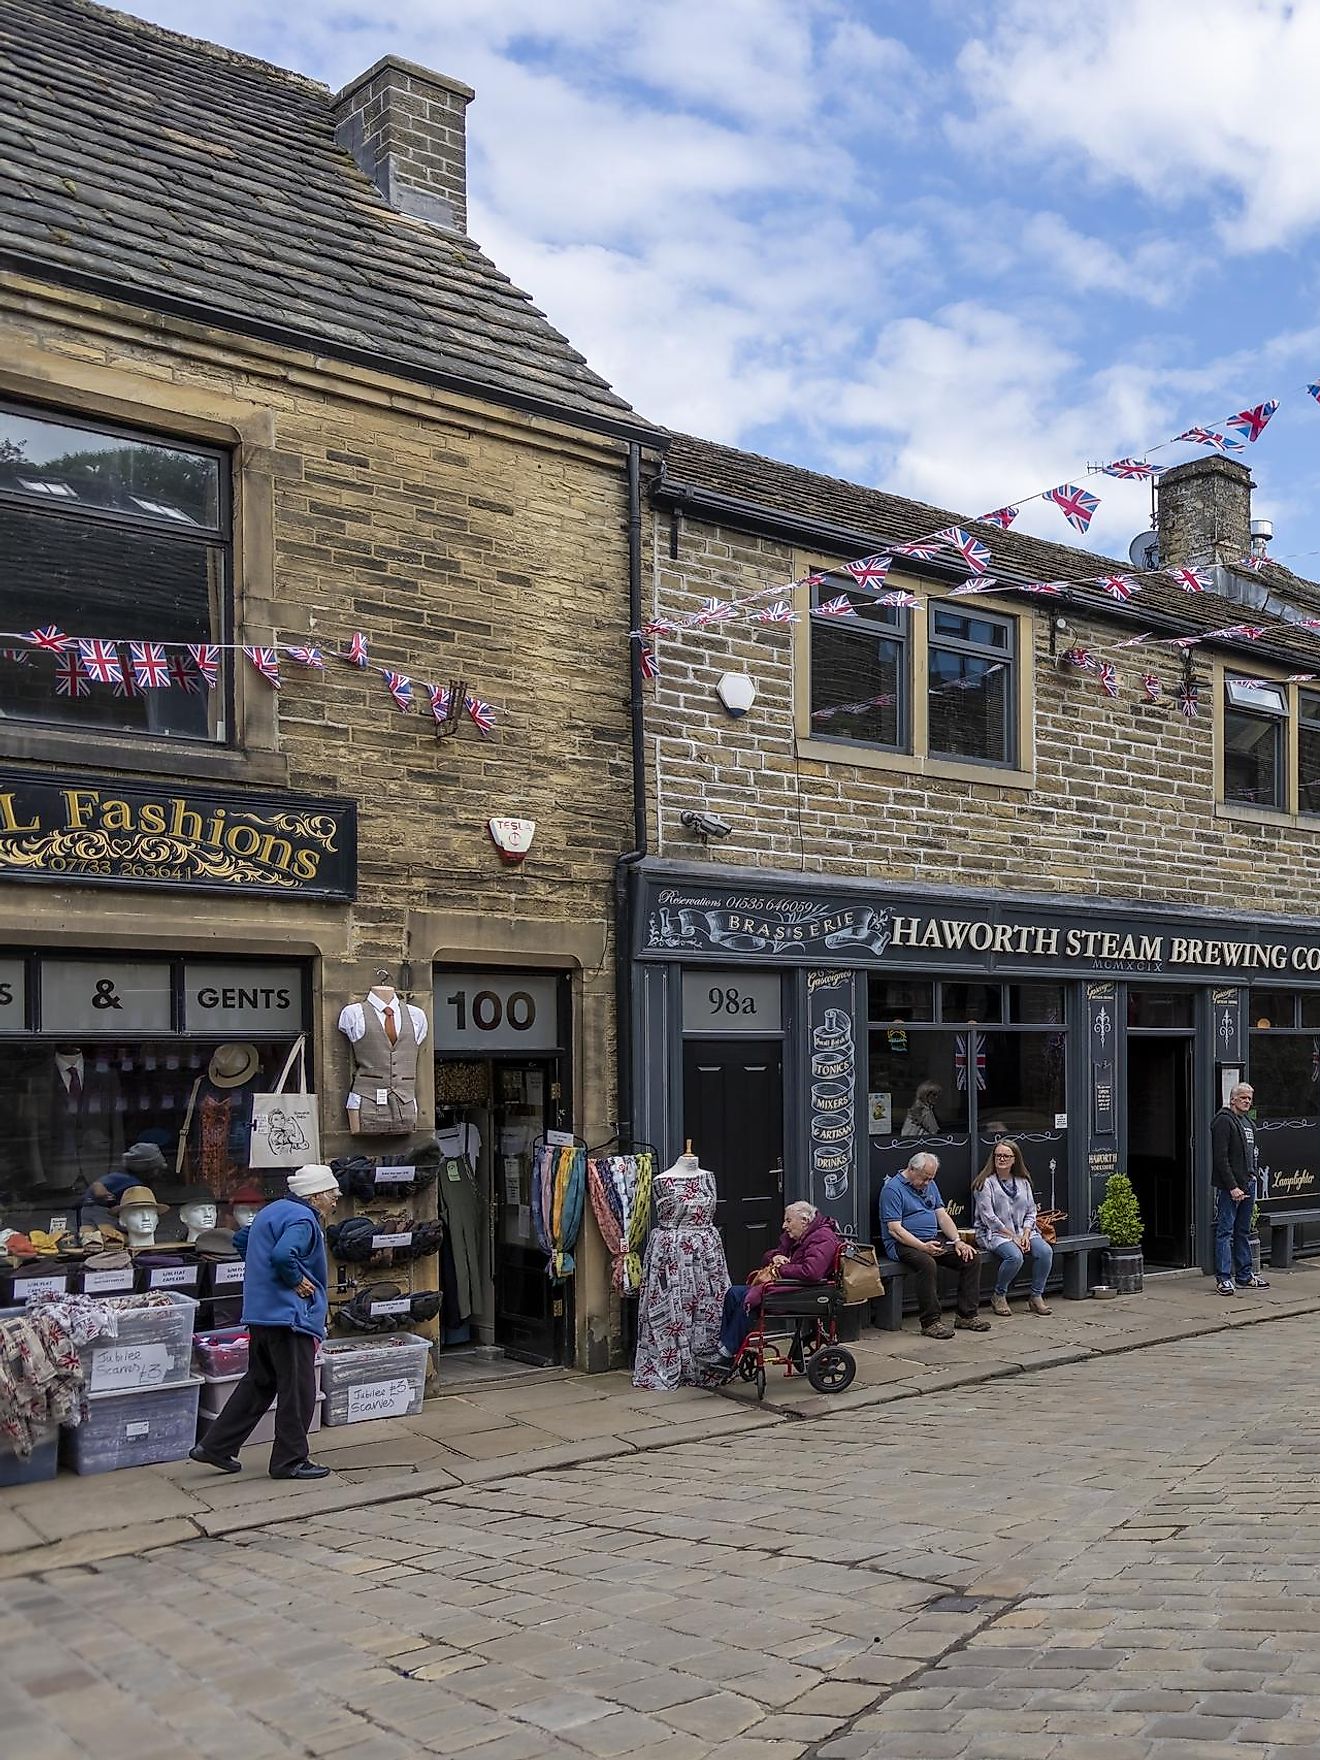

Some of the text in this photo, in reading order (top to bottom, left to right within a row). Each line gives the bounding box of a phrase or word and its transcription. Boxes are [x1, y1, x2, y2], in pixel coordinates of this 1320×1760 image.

[60, 789, 321, 879] Fashions
[496, 821, 532, 831] TESLA
[50, 857, 192, 880] 07733 263641
[658, 889, 722, 907] Reservations
[726, 896, 765, 909] 01535
[728, 911, 854, 940] BRASSERIE
[890, 916, 1061, 955] HAWORTH
[1065, 928, 1164, 962] STEAM
[1168, 937, 1287, 969] BREWING
[1091, 959, 1164, 973] MCMXCIX
[92, 979, 123, 1010] &
[197, 988, 291, 1010] GENTS
[708, 987, 757, 1015] 98a
[447, 990, 536, 1031] 100
[815, 1060, 850, 1075] TONICS
[816, 1096, 849, 1110] MIXERS
[820, 1125, 851, 1140] ARTISAN
[816, 1154, 848, 1168] DRINKS
[1271, 1169, 1315, 1193] Lamplighter
[354, 1388, 386, 1400] Jubilee
